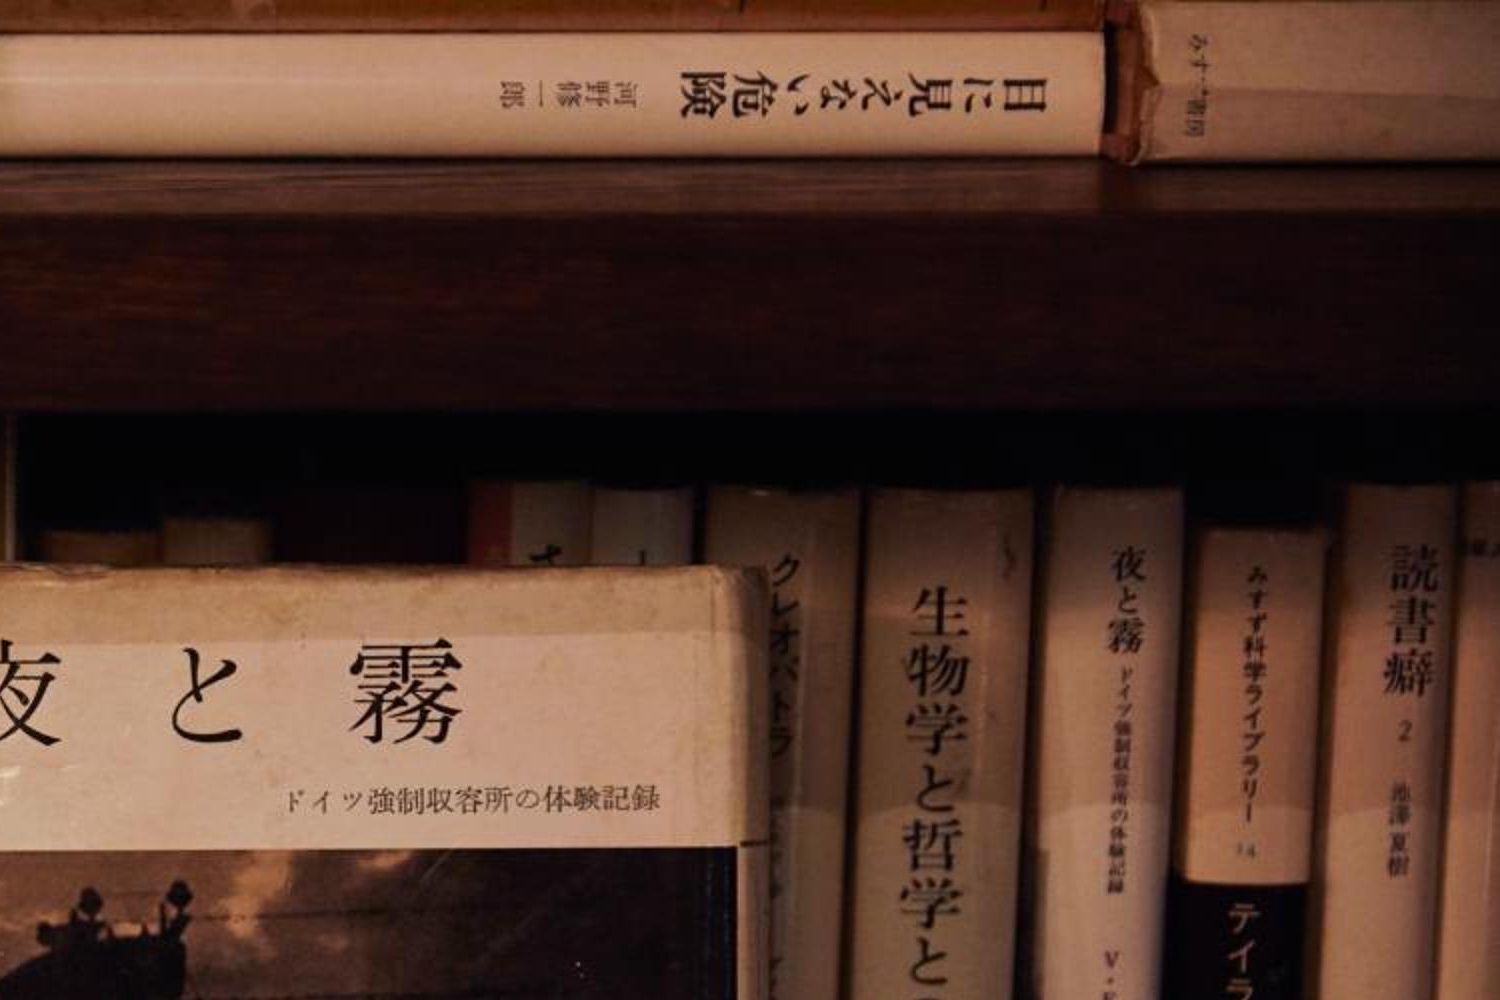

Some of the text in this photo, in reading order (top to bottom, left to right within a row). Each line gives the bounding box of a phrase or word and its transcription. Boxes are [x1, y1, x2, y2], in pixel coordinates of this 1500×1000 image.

[499, 79, 639, 109] 河野修一郎
[679, 70, 1048, 119] 目に見えない危険
[1106, 546, 1147, 655] 夜と霧
[1382, 543, 1439, 698] 読書癖
[1241, 565, 1269, 822] みすず科学ライブラリー
[1398, 721, 1413, 743] 2
[286, 785, 660, 816] ドイツ強制収容所の体験記録
